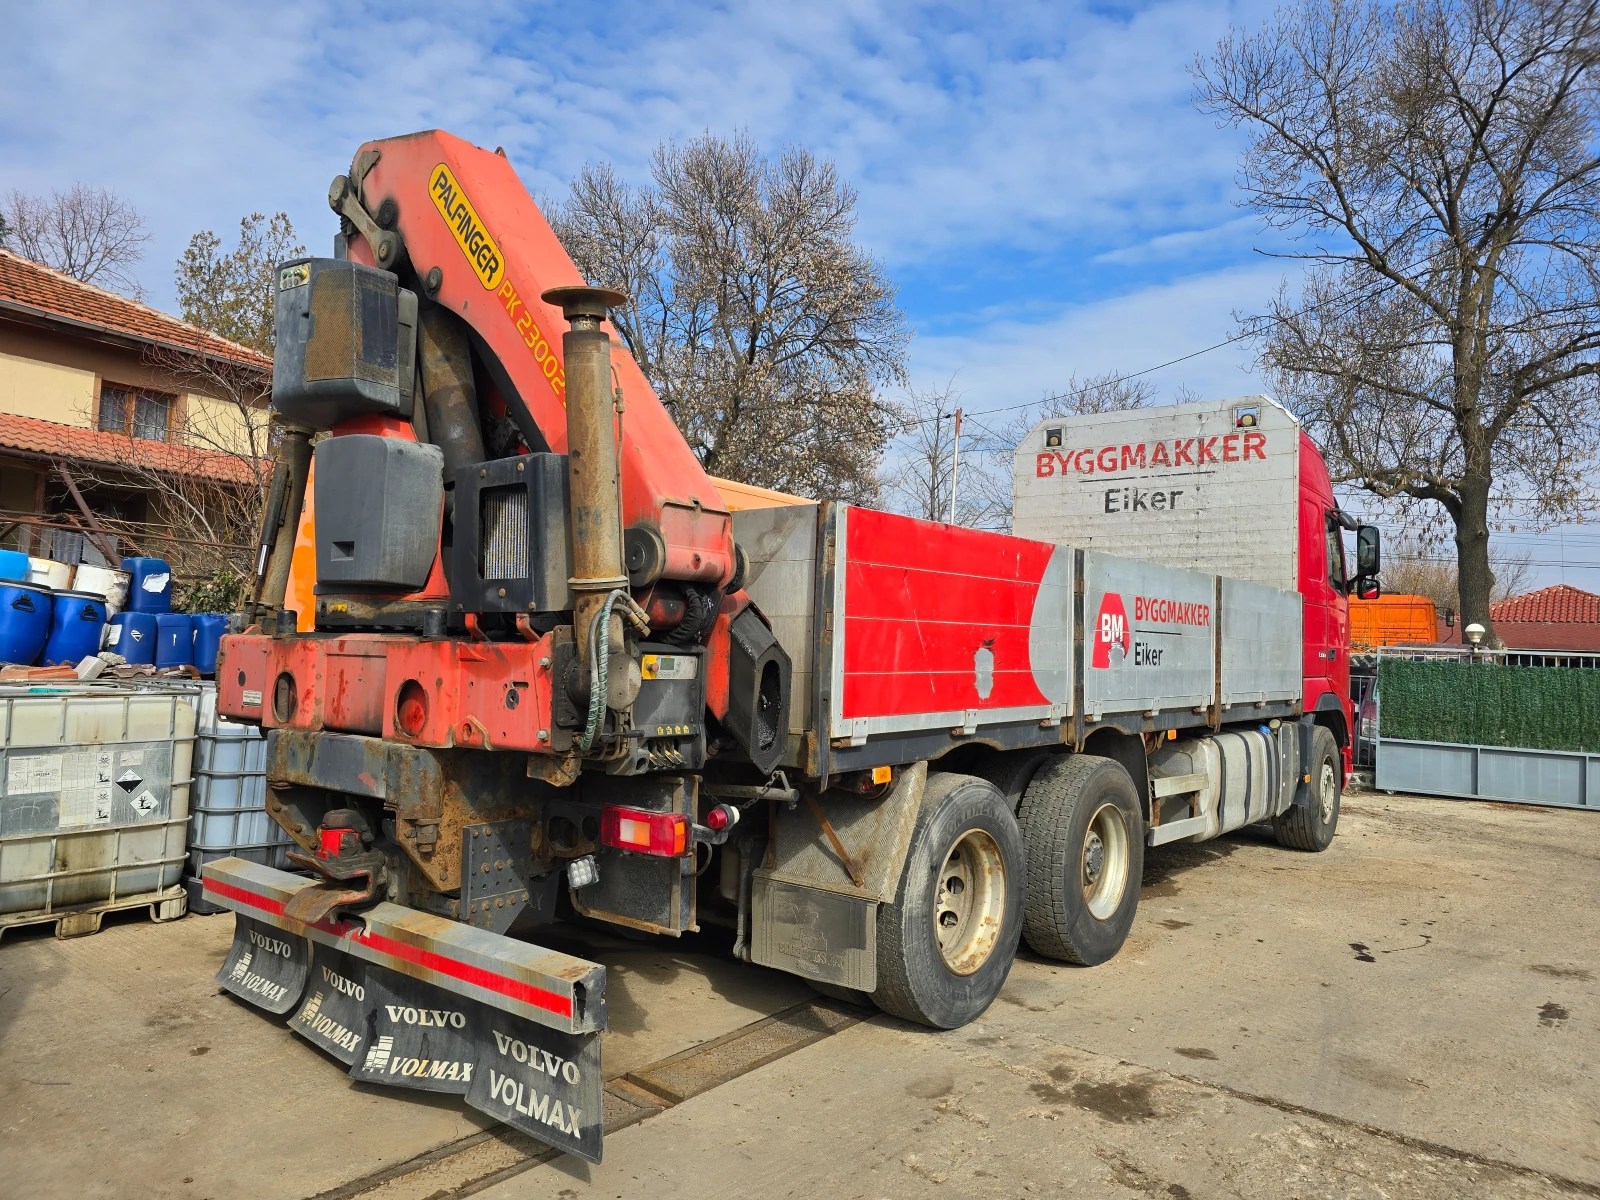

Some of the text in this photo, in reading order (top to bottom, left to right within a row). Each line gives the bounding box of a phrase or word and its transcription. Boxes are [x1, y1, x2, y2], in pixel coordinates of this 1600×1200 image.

[433, 170, 499, 283] PALFINGER
[498, 279, 522, 318] PK
[1036, 432, 1267, 478] BYGGMAKKER
[1104, 487, 1184, 514] Eiker
[1135, 596, 1210, 627] BYGGMAKKER
[1101, 613, 1124, 643] BM
[1135, 642, 1163, 666] Eiker
[249, 928, 292, 958] VOLVO
[241, 971, 289, 1002] VOLMAX
[322, 965, 365, 1001] VOLVO
[311, 1012, 362, 1053] VOLMAX
[385, 1005, 466, 1029] VOLVO
[389, 1056, 474, 1082] VOLMAX
[492, 1029, 581, 1085] VOLVO
[490, 1068, 583, 1140] VOLMAX
